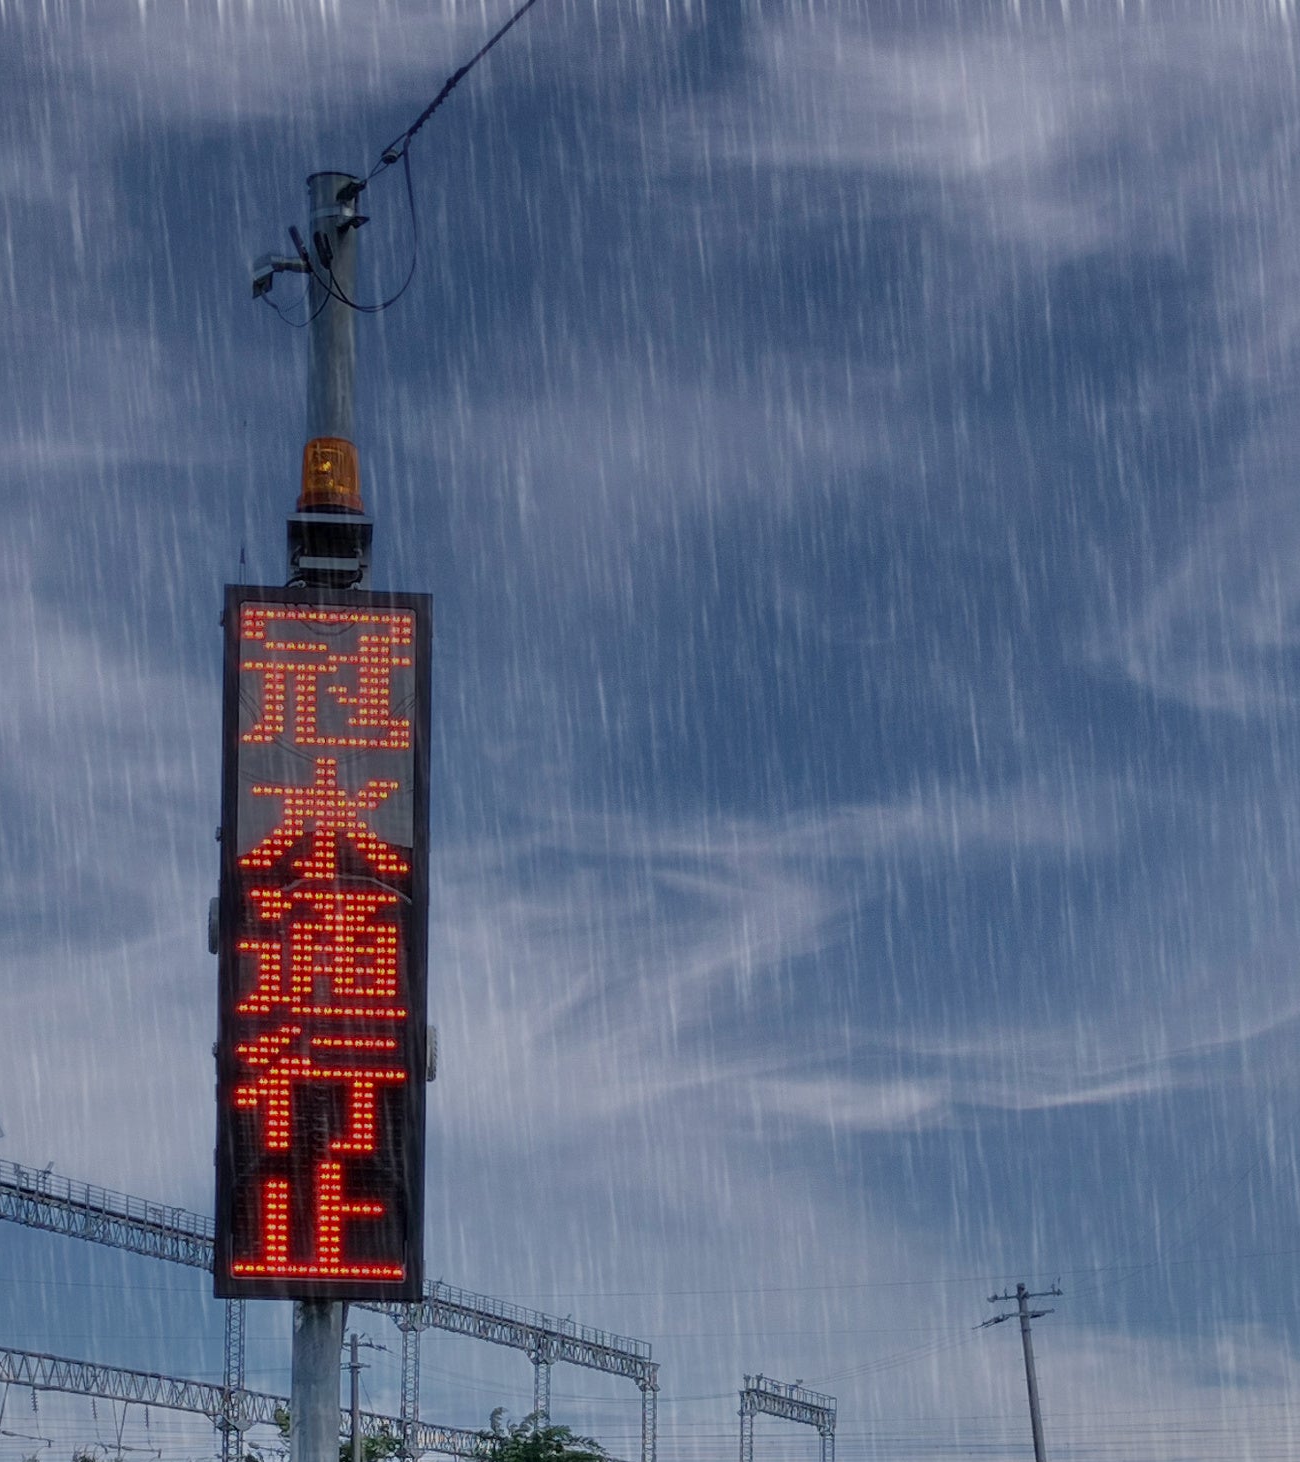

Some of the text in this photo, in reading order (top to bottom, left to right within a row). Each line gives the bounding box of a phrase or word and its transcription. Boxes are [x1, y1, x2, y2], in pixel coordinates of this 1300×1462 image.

[232, 608, 411, 1278] 冠水通行止
